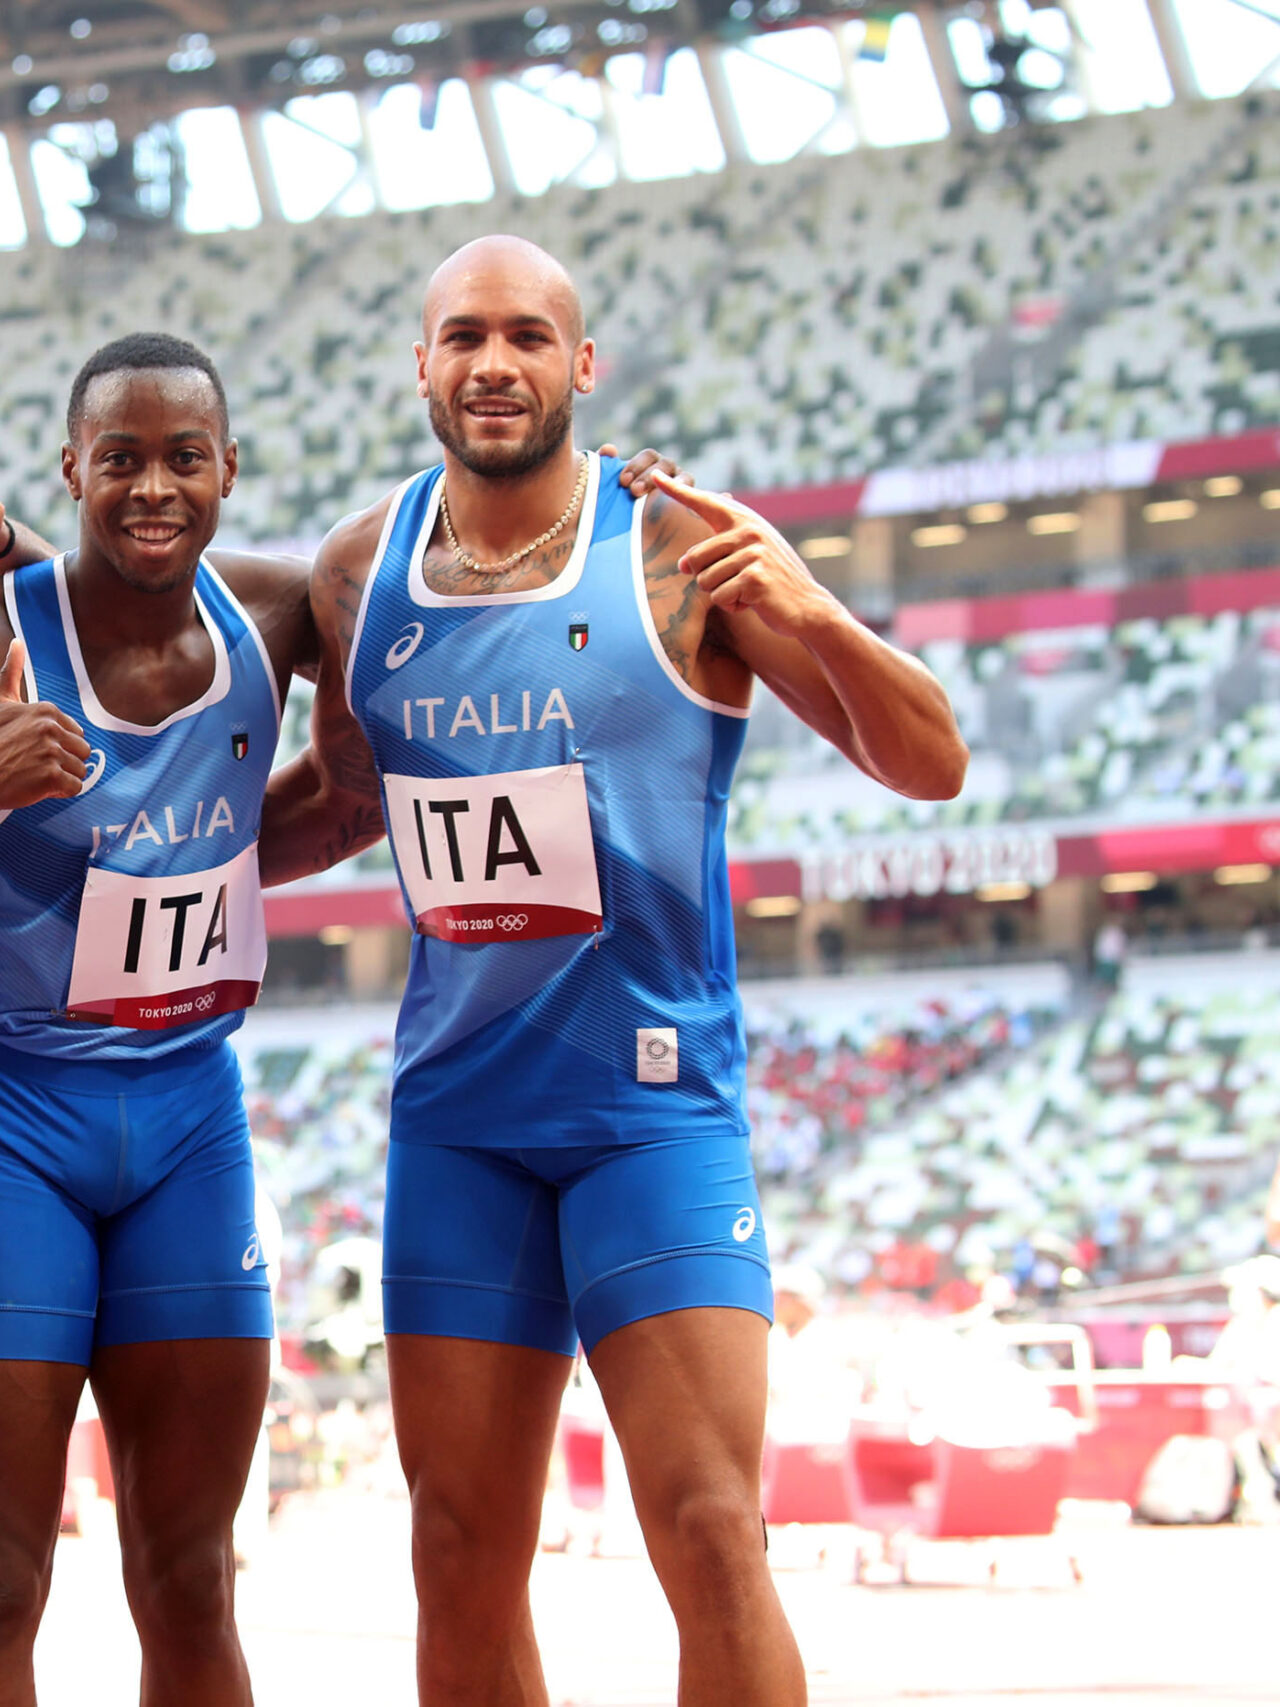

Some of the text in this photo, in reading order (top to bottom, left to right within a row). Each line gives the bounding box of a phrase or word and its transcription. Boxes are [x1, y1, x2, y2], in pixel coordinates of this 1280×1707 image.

[402, 687, 576, 740] ITALIA
[413, 795, 543, 883] ITA
[123, 883, 229, 974] ITA
[469, 918, 494, 931] 2020
[139, 1001, 193, 1019] TOKYO 2020
